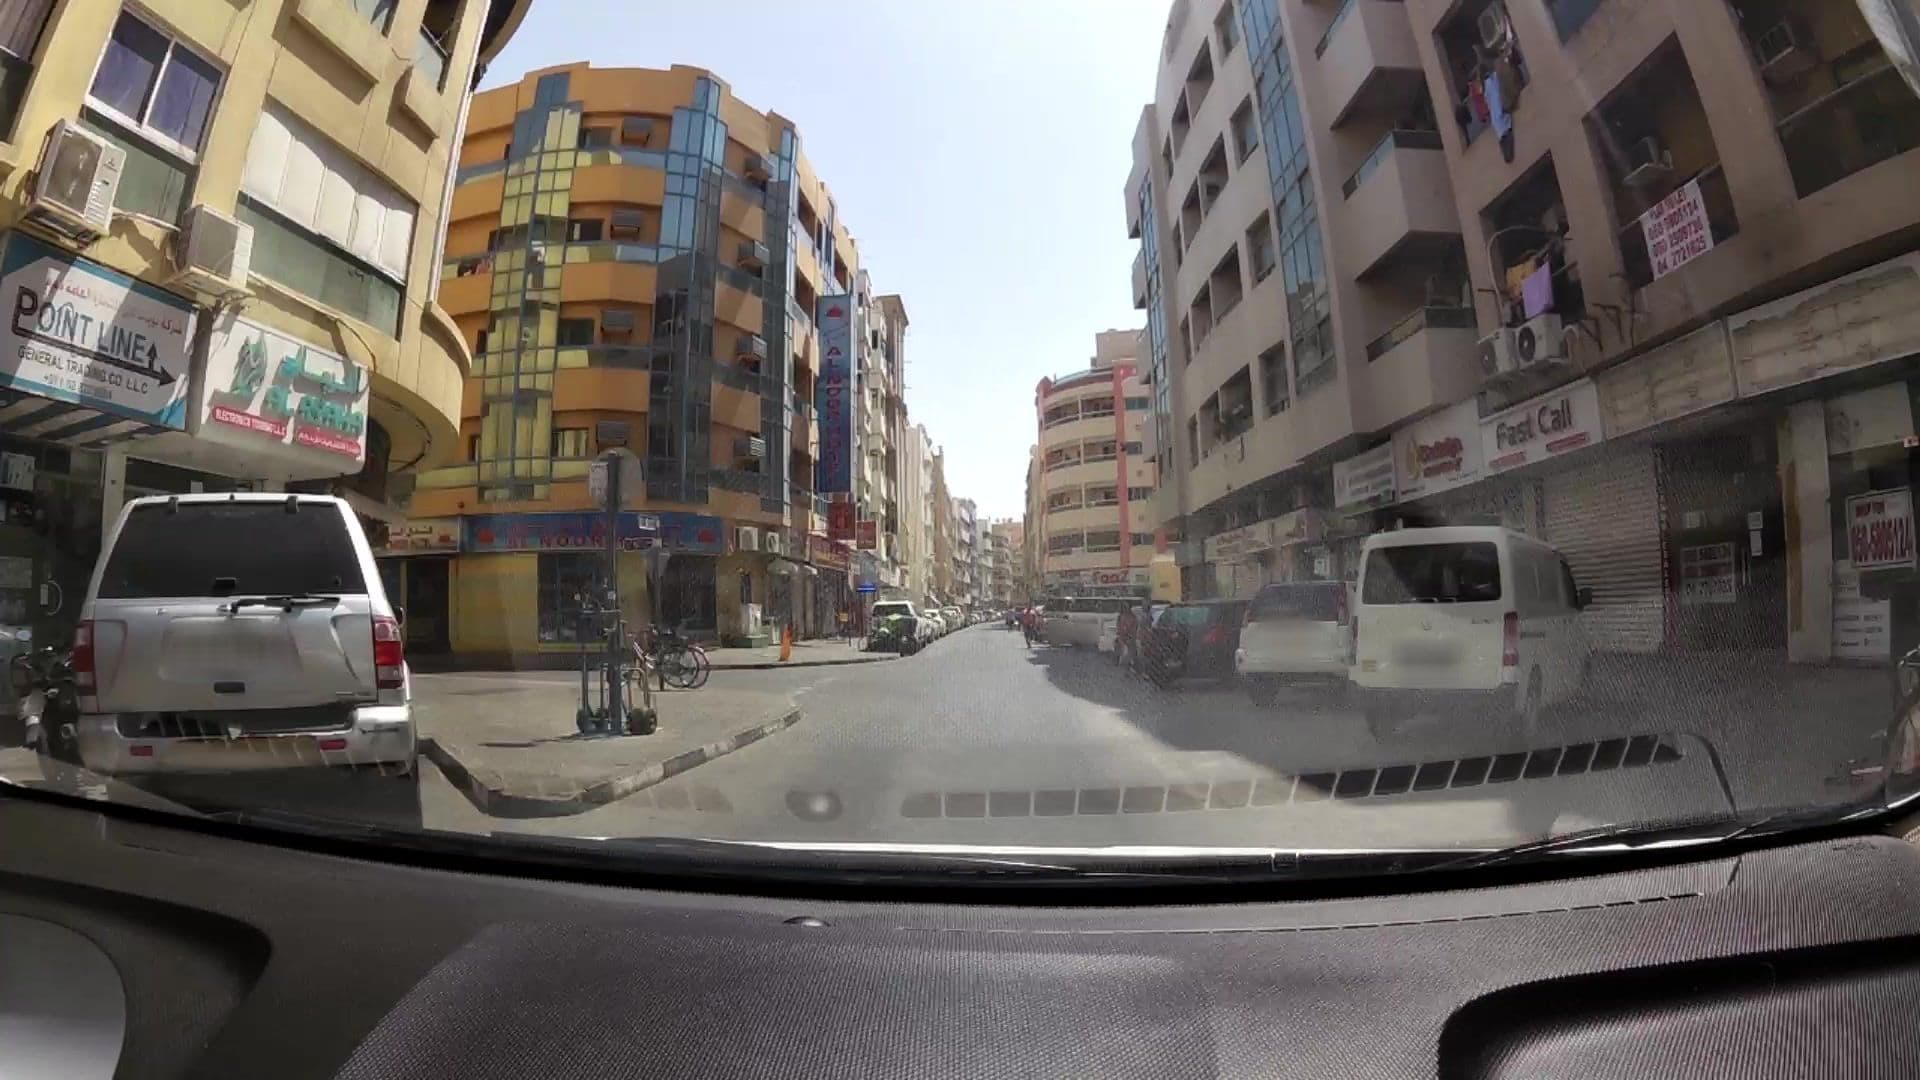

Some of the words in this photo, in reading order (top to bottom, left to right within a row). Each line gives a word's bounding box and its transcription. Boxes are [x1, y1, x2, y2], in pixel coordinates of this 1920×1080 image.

[12, 285, 93, 346] POINT
[97, 321, 148, 363] LINE
[18, 345, 63, 371] GENERAL
[65, 358, 109, 384] TRADING
[125, 376, 148, 395] LLC
[1496, 418, 1534, 449] Fast
[1538, 399, 1573, 434] Call
